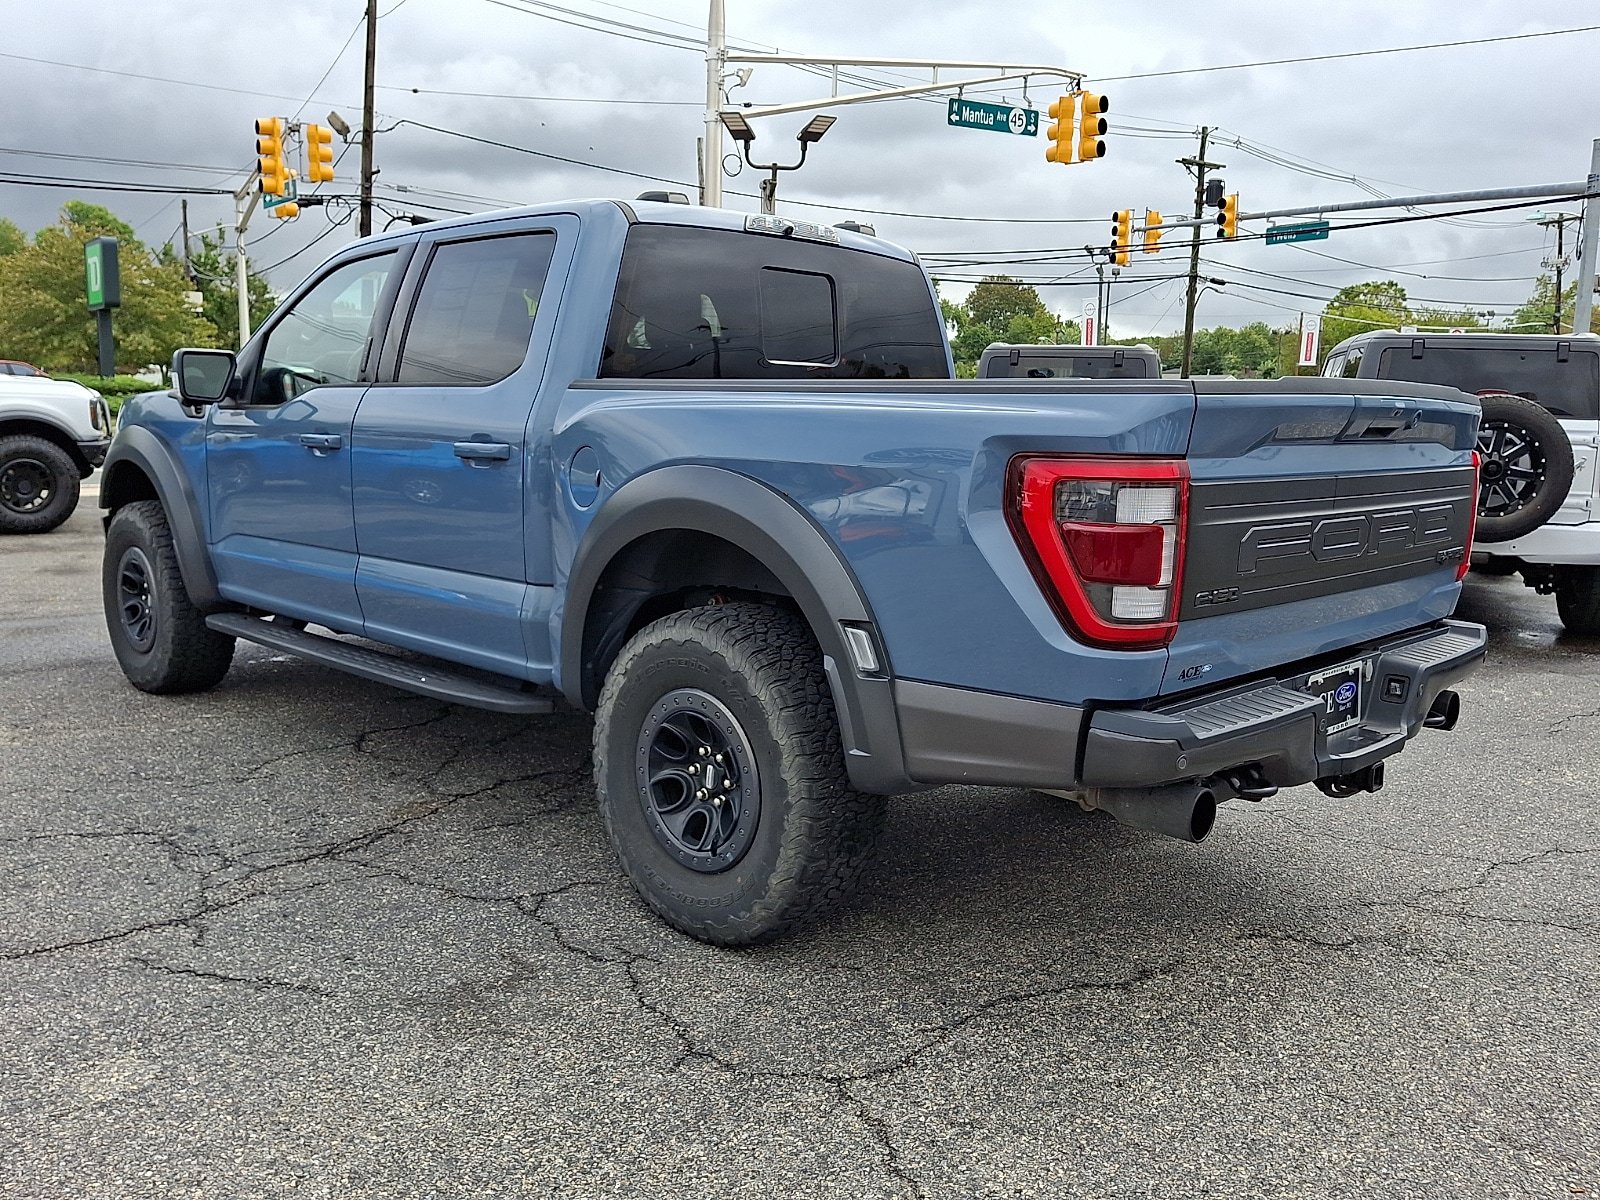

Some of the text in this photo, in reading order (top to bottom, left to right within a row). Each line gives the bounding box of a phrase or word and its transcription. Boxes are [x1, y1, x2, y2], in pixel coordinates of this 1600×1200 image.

[952, 101, 959, 112] N
[961, 105, 994, 126] Mantua
[1010, 112, 1024, 128] 45
[1030, 112, 1036, 123] S
[1237, 505, 1455, 576] FORD
[1177, 664, 1203, 681] ACE
